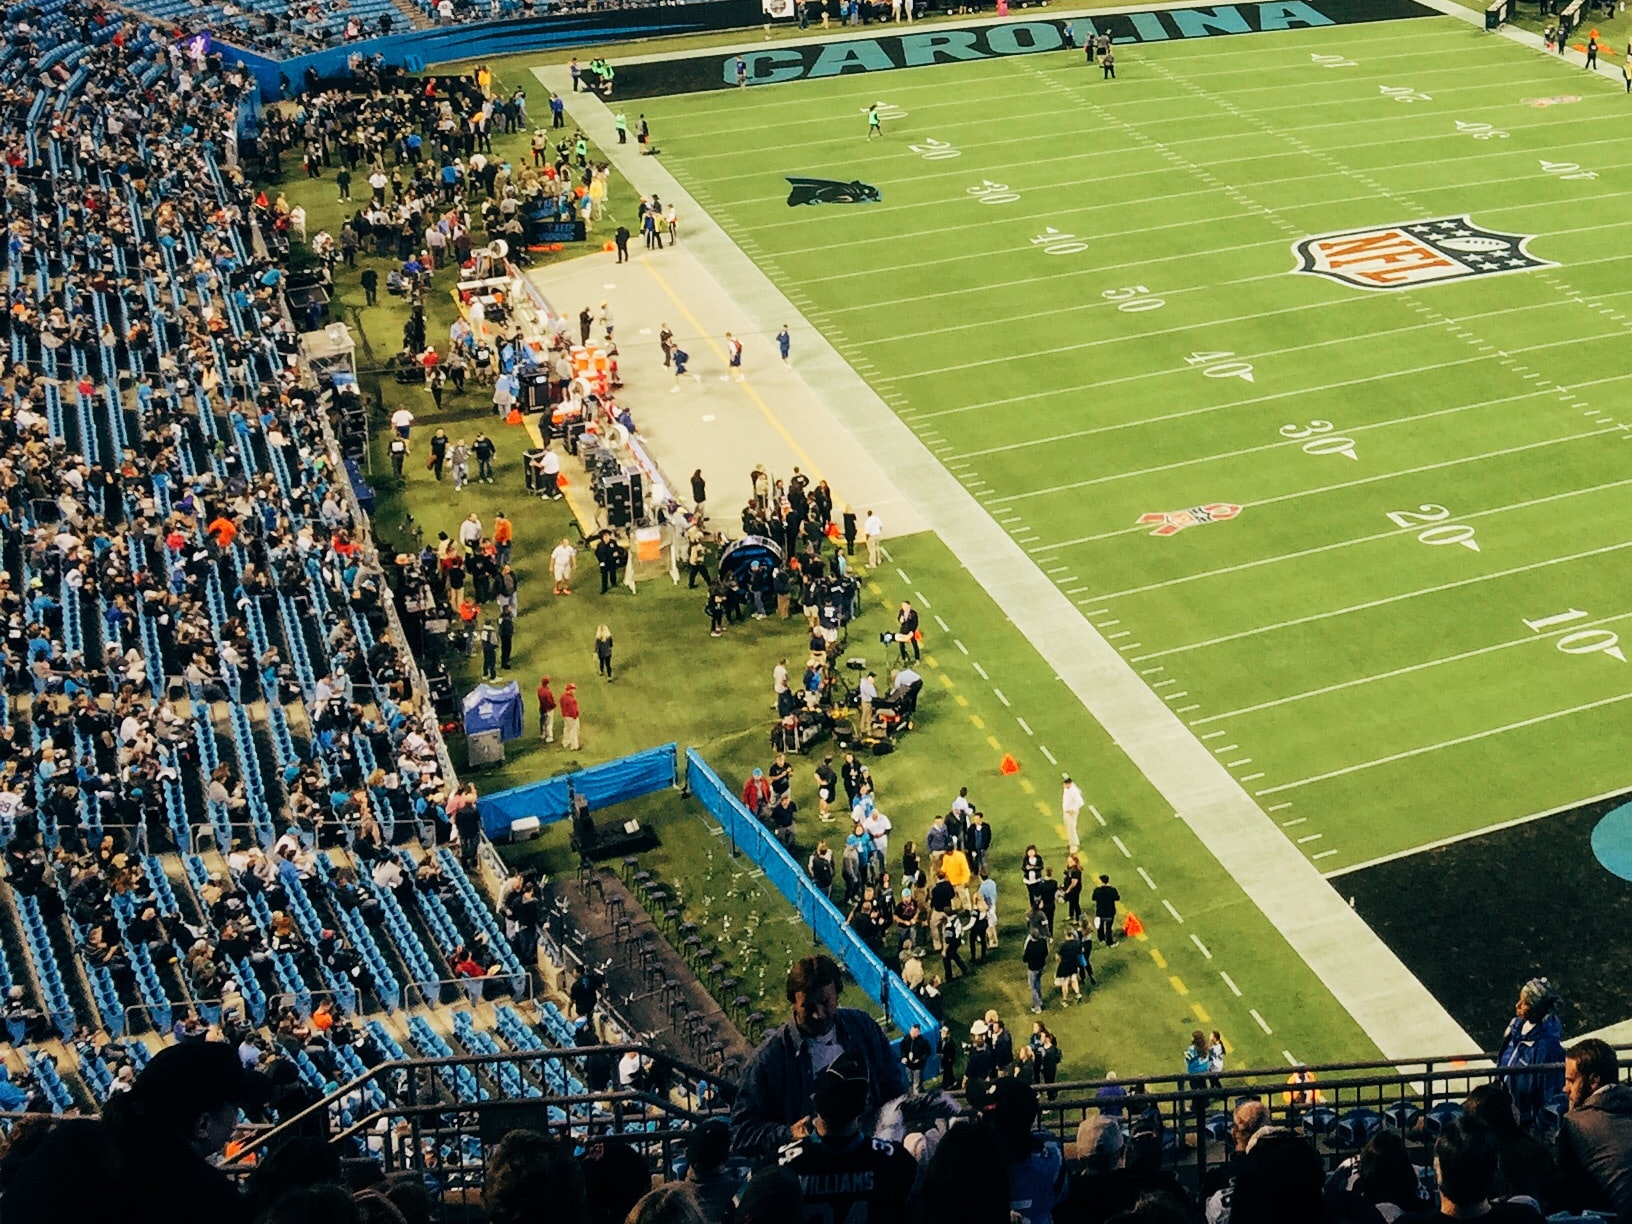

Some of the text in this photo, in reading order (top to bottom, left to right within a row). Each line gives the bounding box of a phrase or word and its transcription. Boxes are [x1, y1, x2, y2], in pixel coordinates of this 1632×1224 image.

[722, 0, 1334, 87] CAROLINA
[907, 141, 962, 160] 20
[965, 182, 1021, 205] 30
[1030, 233, 1090, 256] 40
[1318, 231, 1458, 284] NFL
[1101, 284, 1166, 313] 50
[1184, 350, 1254, 380] 40
[1279, 419, 1357, 456] 30
[1385, 503, 1475, 545] 20
[1521, 607, 1619, 654] 10
